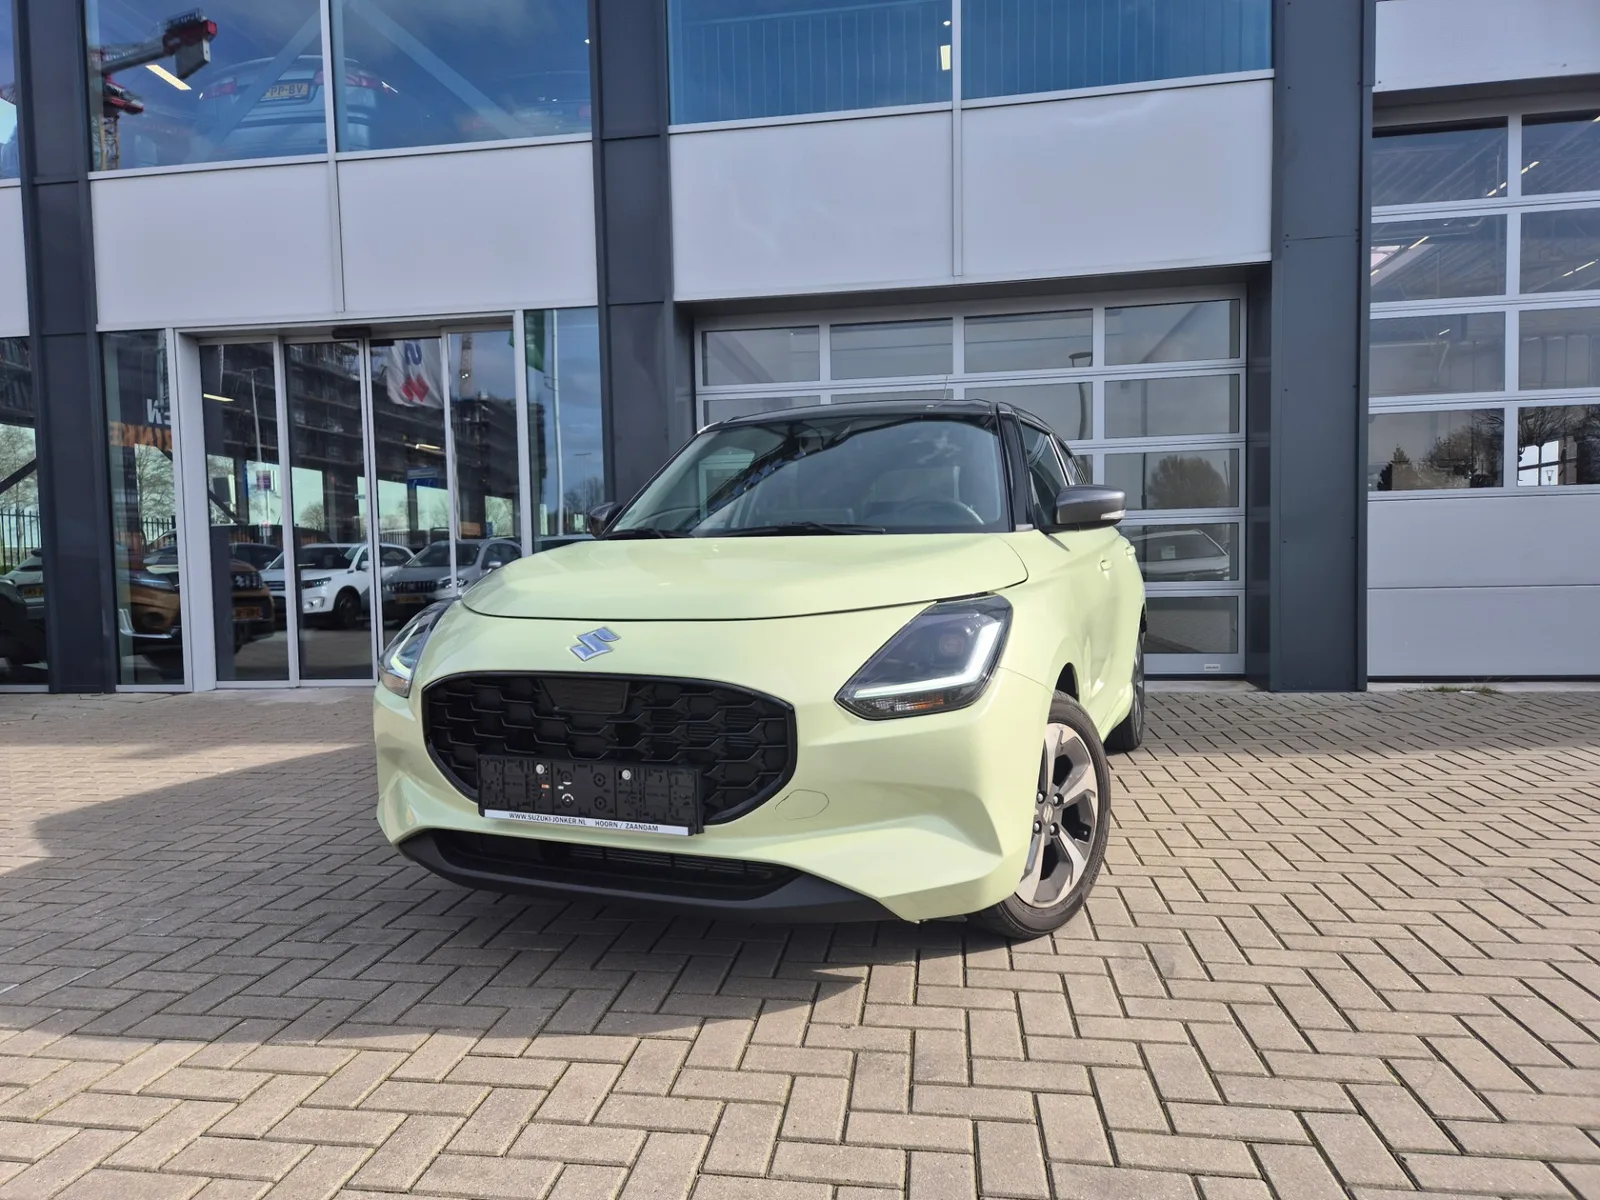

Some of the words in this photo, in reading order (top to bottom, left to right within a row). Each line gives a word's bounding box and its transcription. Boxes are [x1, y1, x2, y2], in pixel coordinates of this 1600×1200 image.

[508, 812, 587, 826] WWW.SUZUKI-JONKER.NL
[594, 821, 619, 829] HOORN
[625, 823, 659, 832] ZAANDAM
